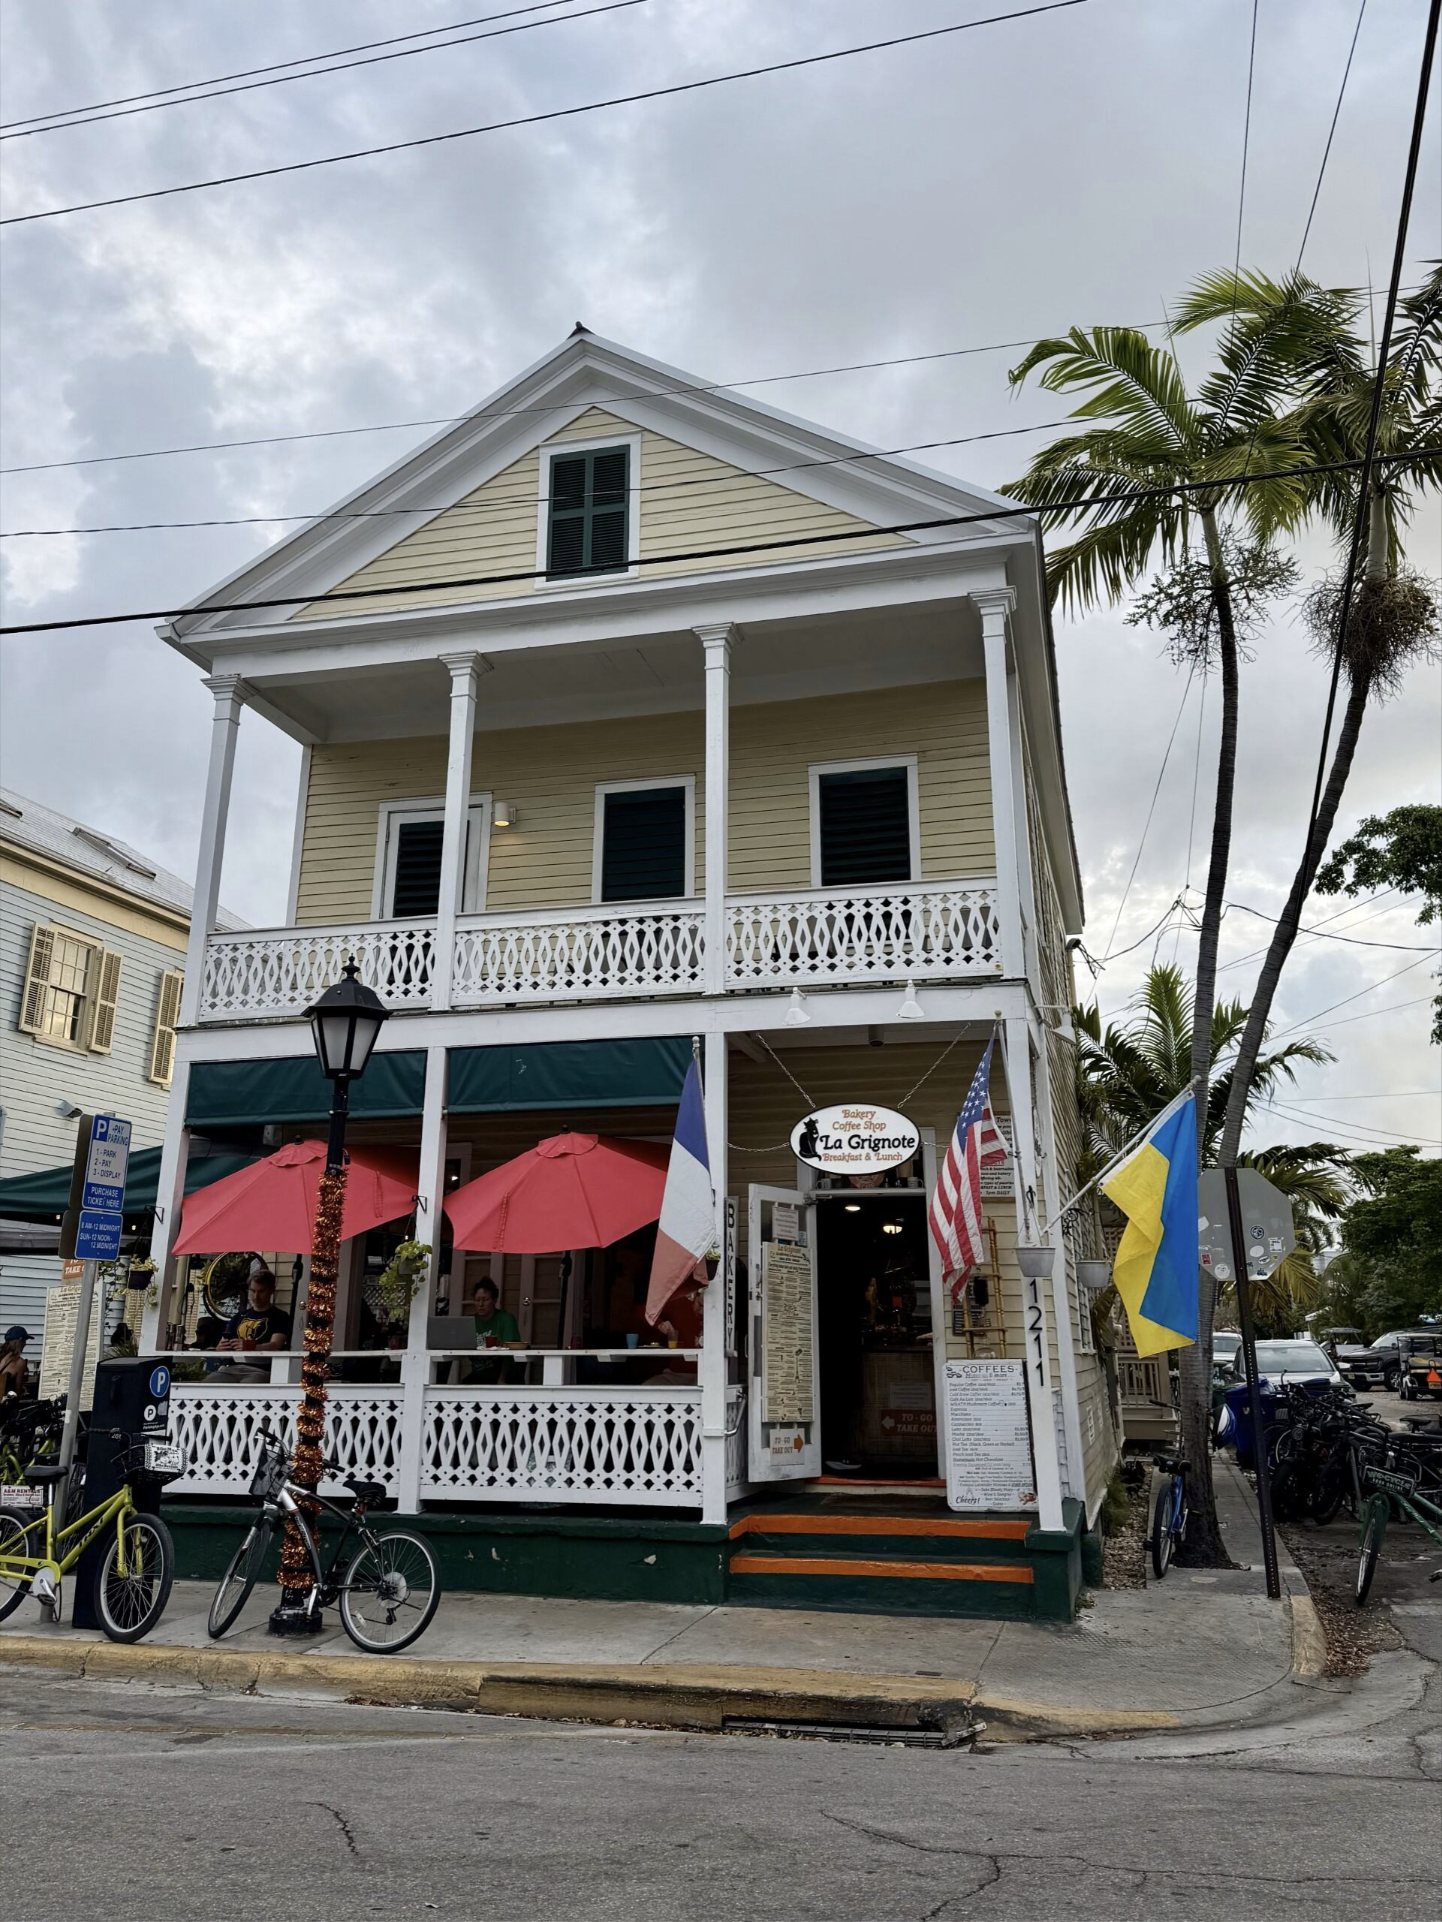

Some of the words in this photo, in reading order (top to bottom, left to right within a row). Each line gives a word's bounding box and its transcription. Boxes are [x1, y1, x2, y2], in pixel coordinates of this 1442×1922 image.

[842, 1109, 876, 1120] Bakery
[96, 1120, 107, 1138] P
[832, 1121, 861, 1132] Coffee
[864, 1120, 887, 1133] Shop
[108, 1133, 128, 1146] PARKING
[819, 1134, 842, 1150] La
[848, 1134, 916, 1152] Grignote
[103, 1149, 117, 1158] PARK
[822, 1152, 862, 1163] Breakfast
[864, 1152, 871, 1161] &
[874, 1152, 903, 1161] Lunch
[102, 1159, 112, 1167] PAY
[100, 1170, 121, 1179] DISPLAY
[91, 1186, 119, 1198] PURCHASE
[88, 1196, 106, 1206] TICKET
[106, 1199, 120, 1207] HERE
[65, 1266, 81, 1274] TAKE
[1028, 1278, 1044, 1386] 1211
[157, 1372, 166, 1393] P
